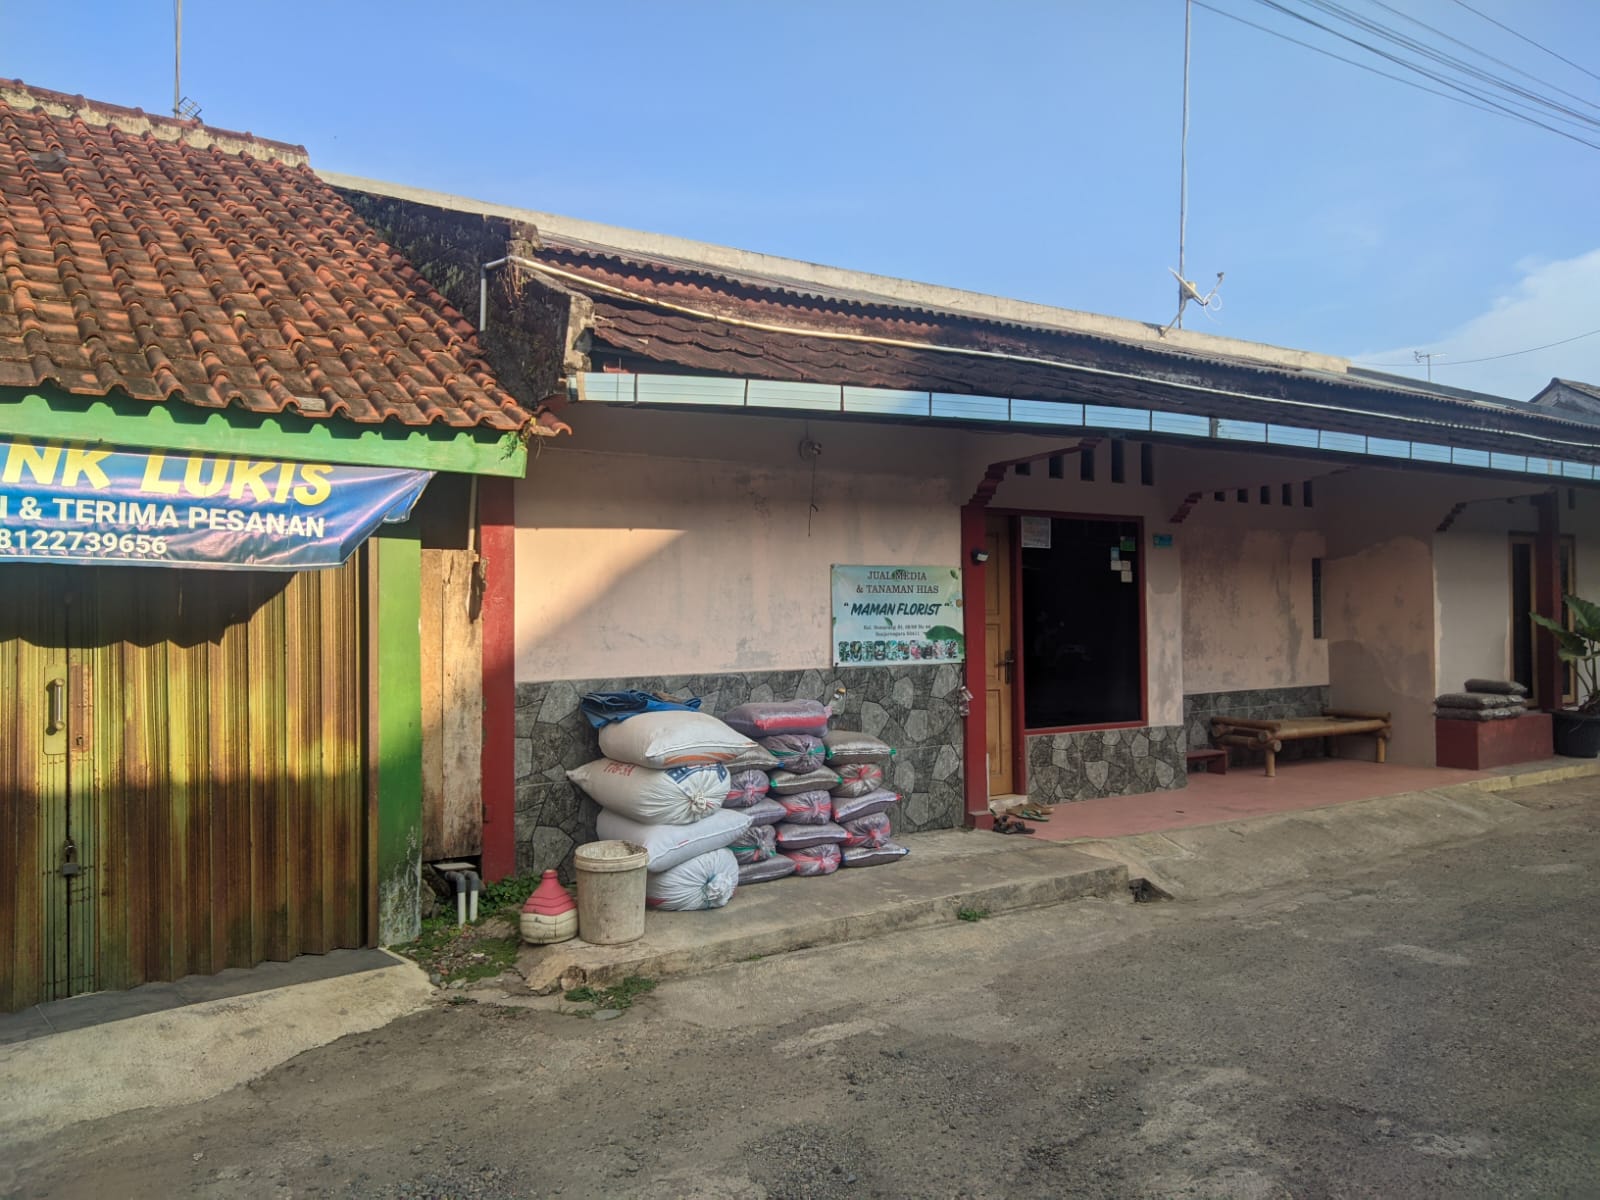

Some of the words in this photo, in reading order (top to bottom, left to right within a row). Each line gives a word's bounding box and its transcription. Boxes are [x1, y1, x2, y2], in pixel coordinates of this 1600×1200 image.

[2, 436, 116, 490] NK
[140, 449, 335, 506] LUKIS
[19, 496, 43, 521] &
[52, 497, 179, 528] TERIMA
[188, 506, 325, 538] PESANAN
[0, 528, 168, 555] 8122739656
[856, 585, 864, 594] &
[866, 585, 914, 594] TANAMAN
[916, 585, 939, 594] HIAS
[867, 571, 892, 580] JUAL
[895, 571, 927, 581] MEDIA
